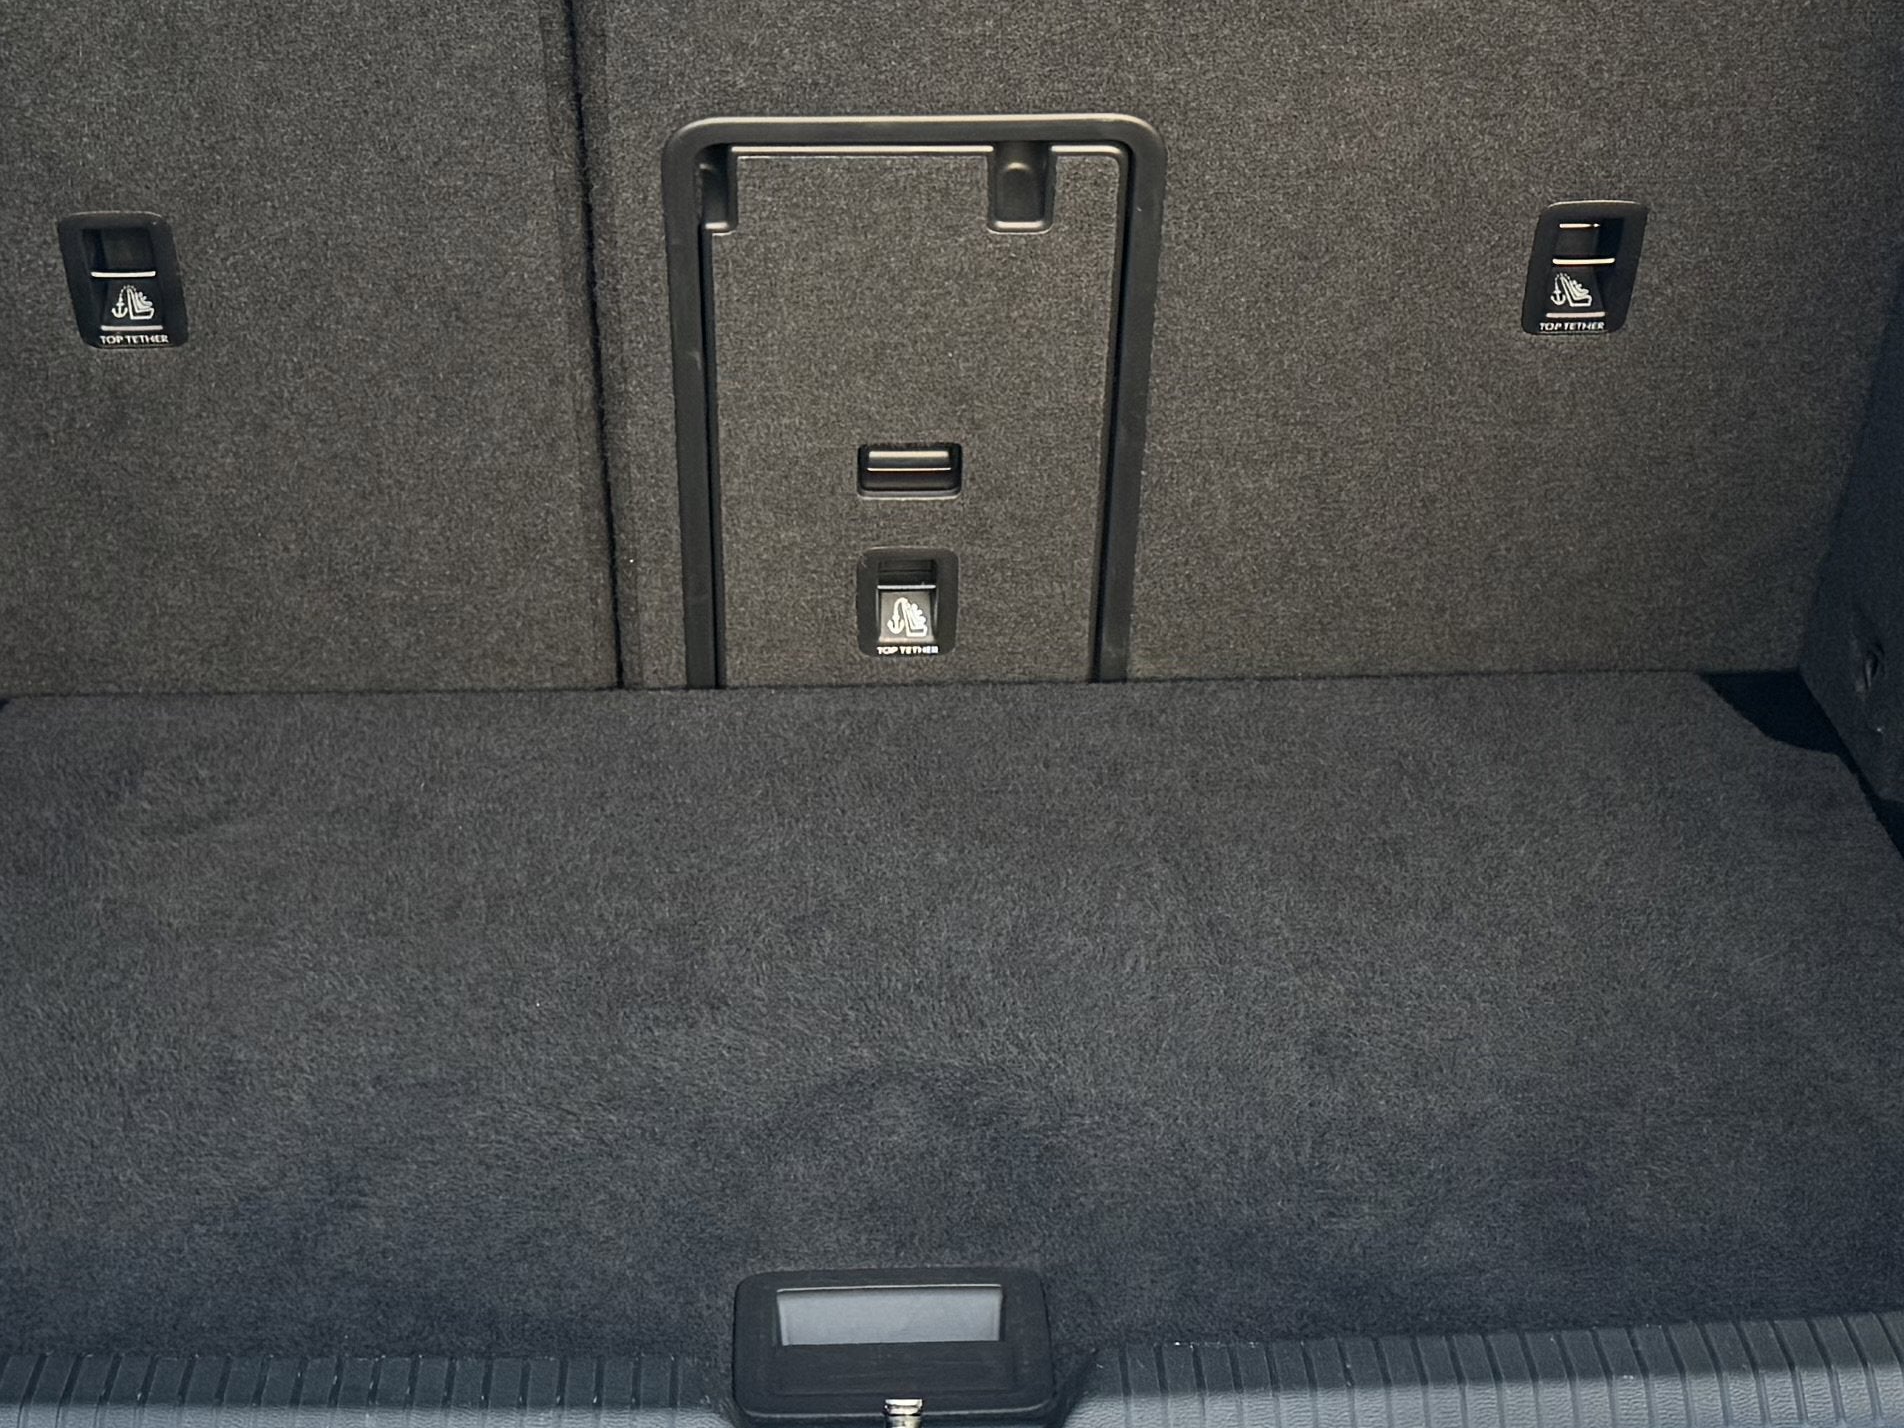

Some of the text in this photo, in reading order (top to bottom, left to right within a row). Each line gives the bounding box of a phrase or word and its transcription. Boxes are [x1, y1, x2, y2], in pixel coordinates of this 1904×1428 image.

[1539, 321, 1605, 331] TOP TETHER
[99, 334, 169, 345] TOP TETHER
[876, 645, 939, 655] TOP TETHER
